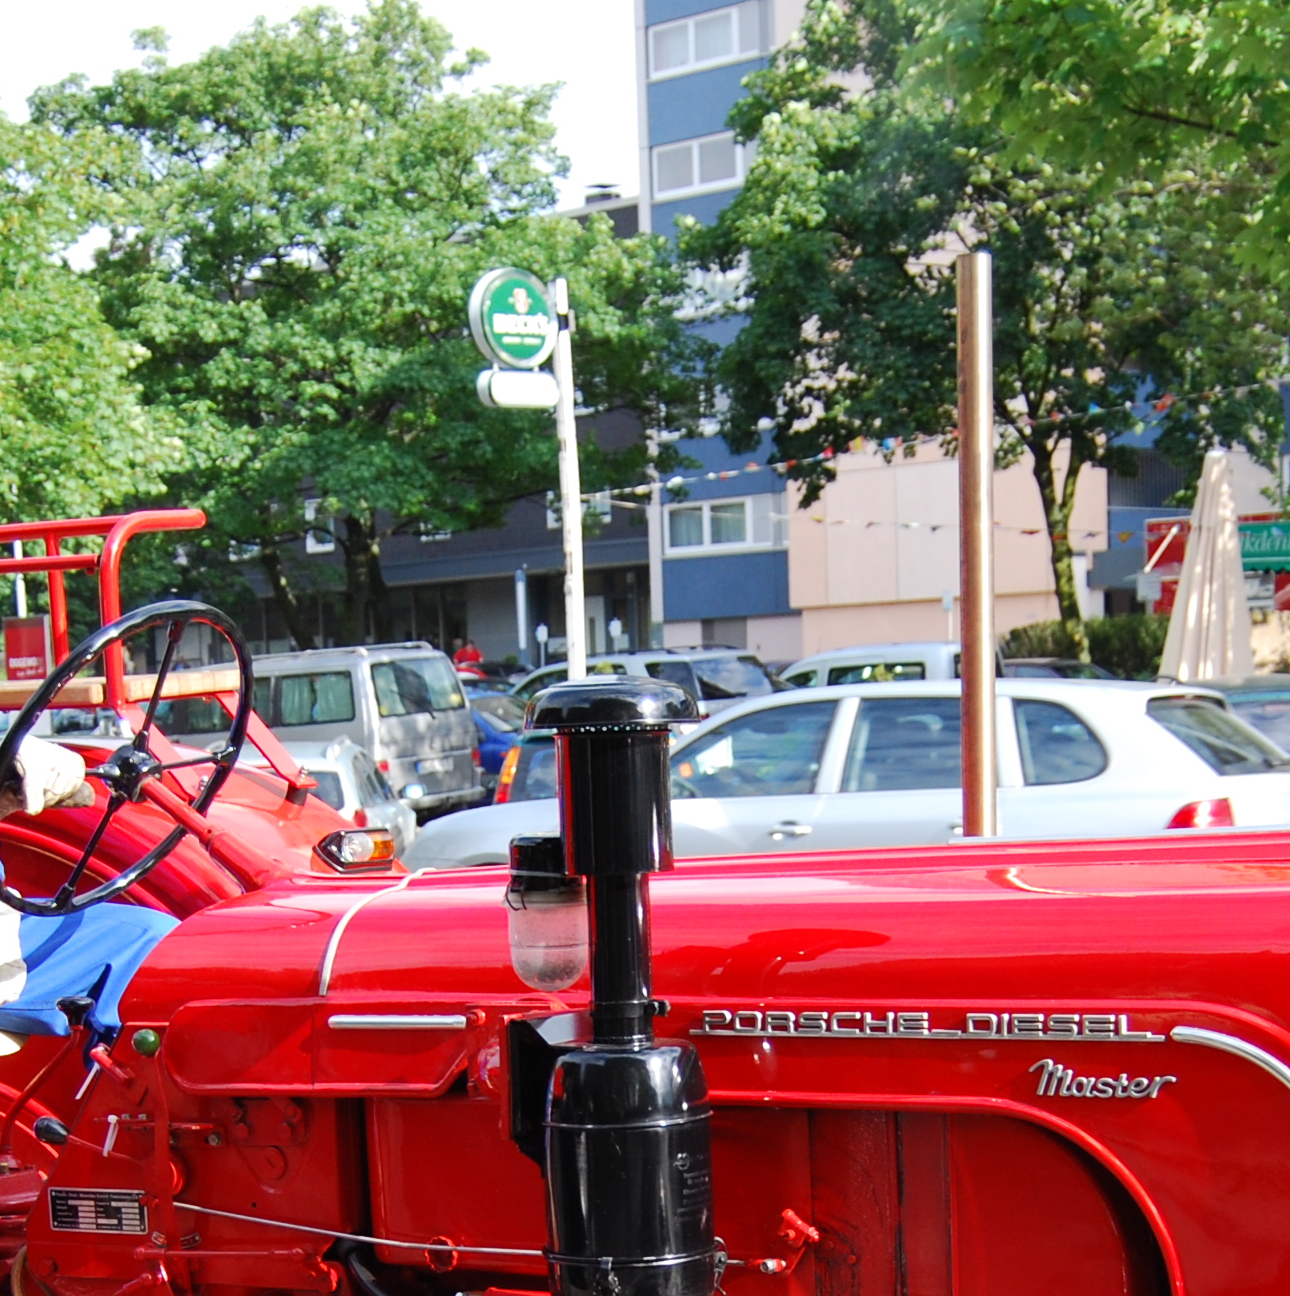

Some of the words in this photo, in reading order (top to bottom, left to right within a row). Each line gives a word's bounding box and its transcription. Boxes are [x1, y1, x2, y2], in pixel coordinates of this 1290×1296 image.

[701, 1009, 930, 1037] PORSCHE
[965, 1012, 1153, 1040] DIESEL
[1028, 1058, 1178, 1099] Master
